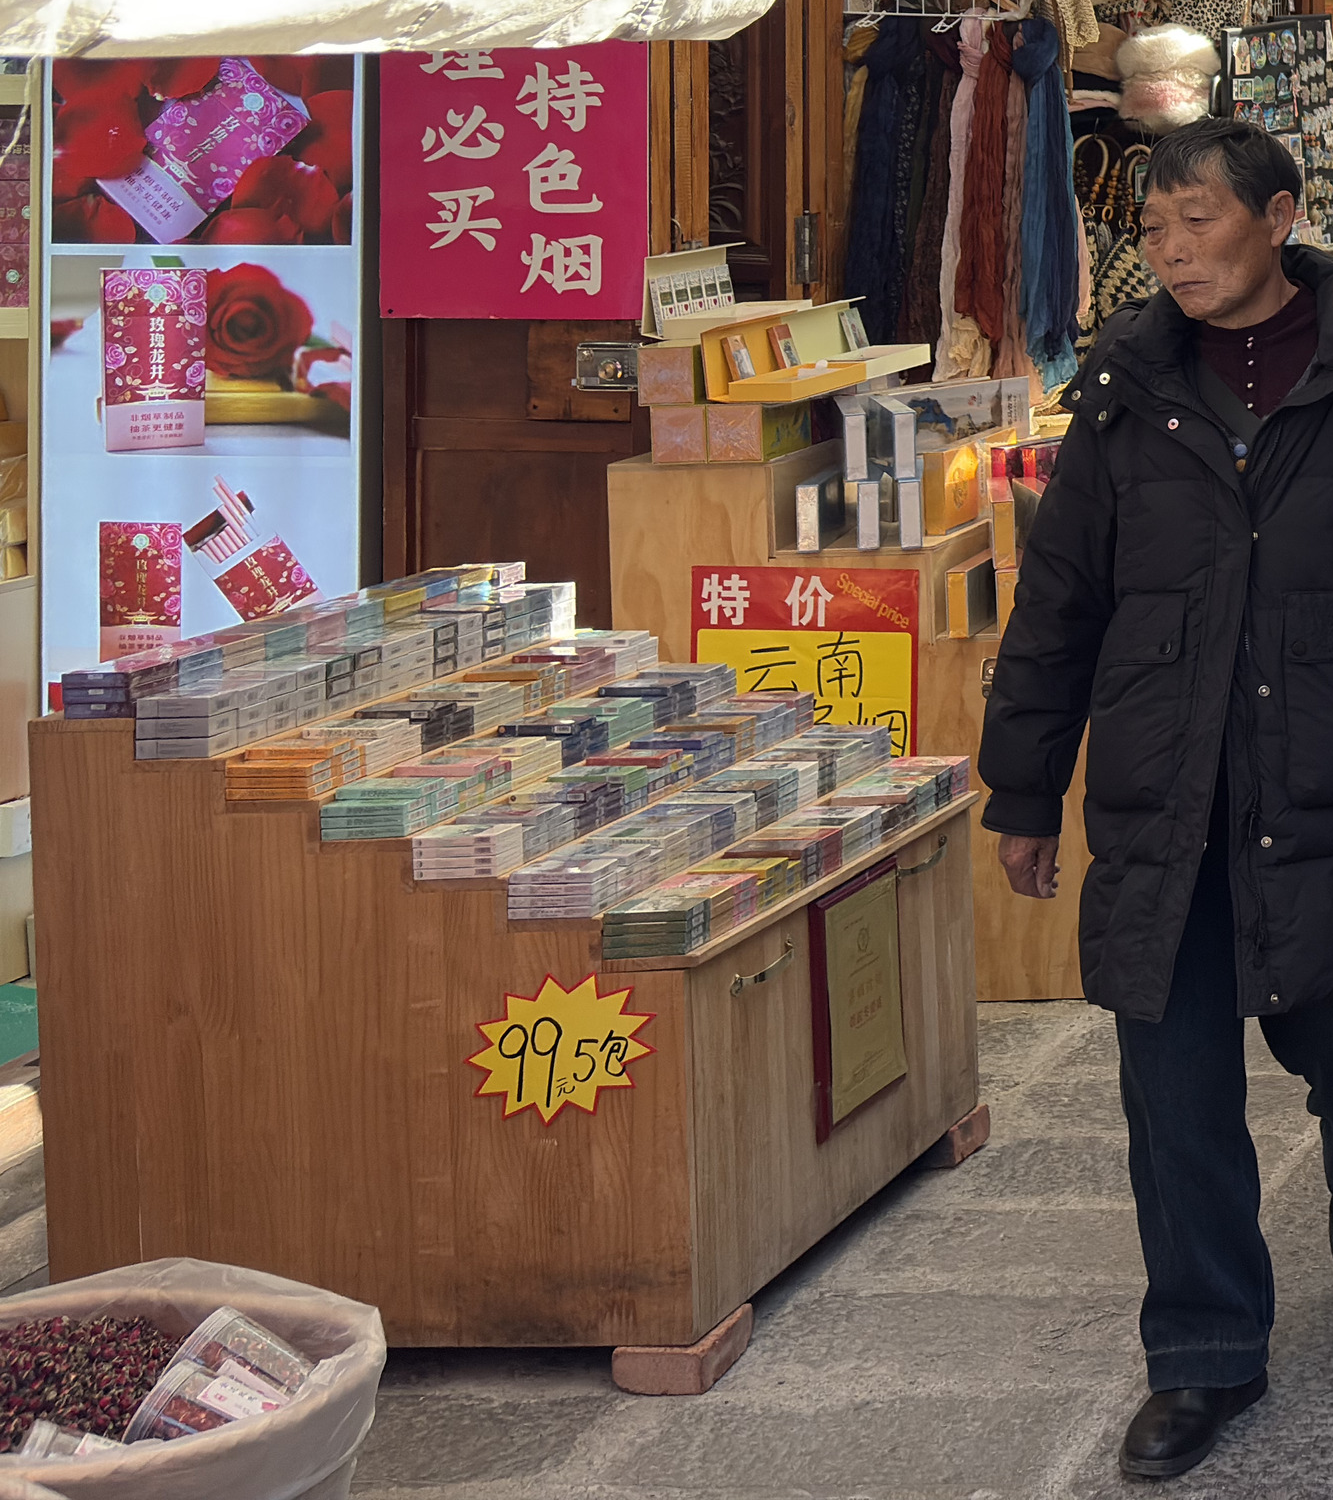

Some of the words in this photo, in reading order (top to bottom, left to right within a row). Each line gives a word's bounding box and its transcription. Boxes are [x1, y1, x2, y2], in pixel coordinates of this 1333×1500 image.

[515, 59, 605, 296] 特色烟
[149, 316, 166, 380] 玫瑰龙井
[700, 573, 834, 628] 特价
[836, 572, 880, 609] Special
[876, 602, 910, 629] price
[744, 631, 864, 698] 云南
